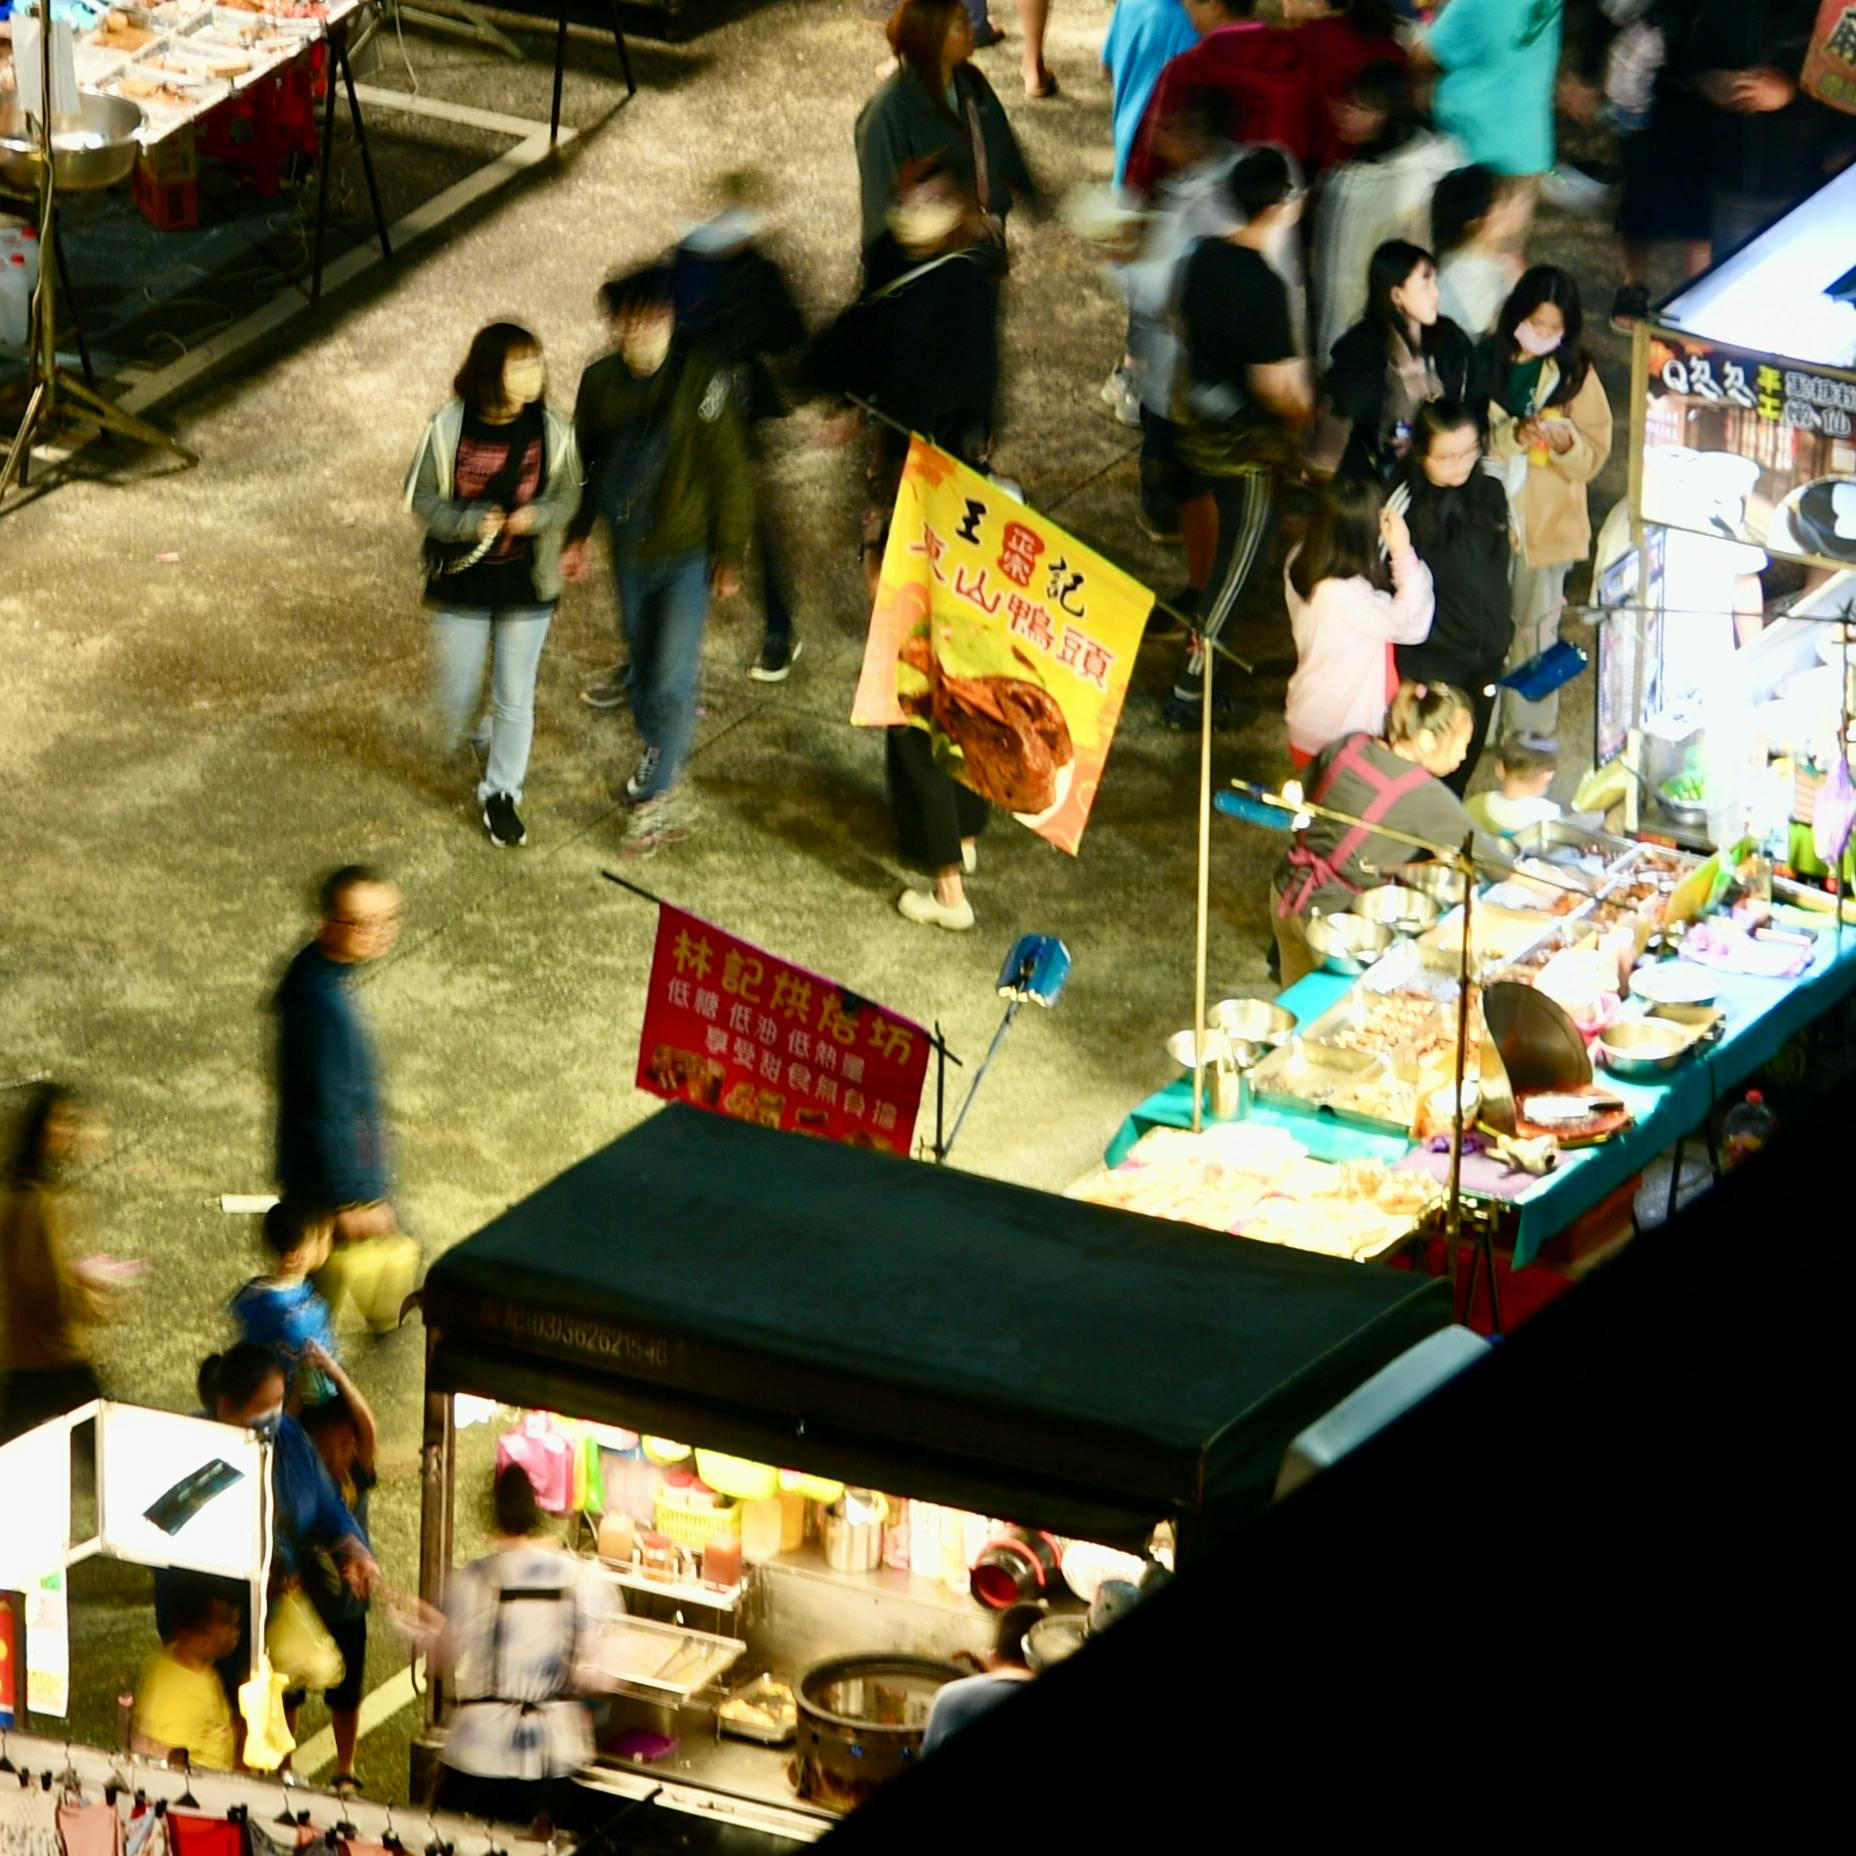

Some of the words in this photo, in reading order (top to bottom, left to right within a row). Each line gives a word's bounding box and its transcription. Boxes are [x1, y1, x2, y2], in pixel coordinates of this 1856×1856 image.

[955, 497, 987, 546] 王
[1046, 555, 1085, 618] 記
[667, 976, 720, 1021] 低糖
[729, 1001, 779, 1046] 低油
